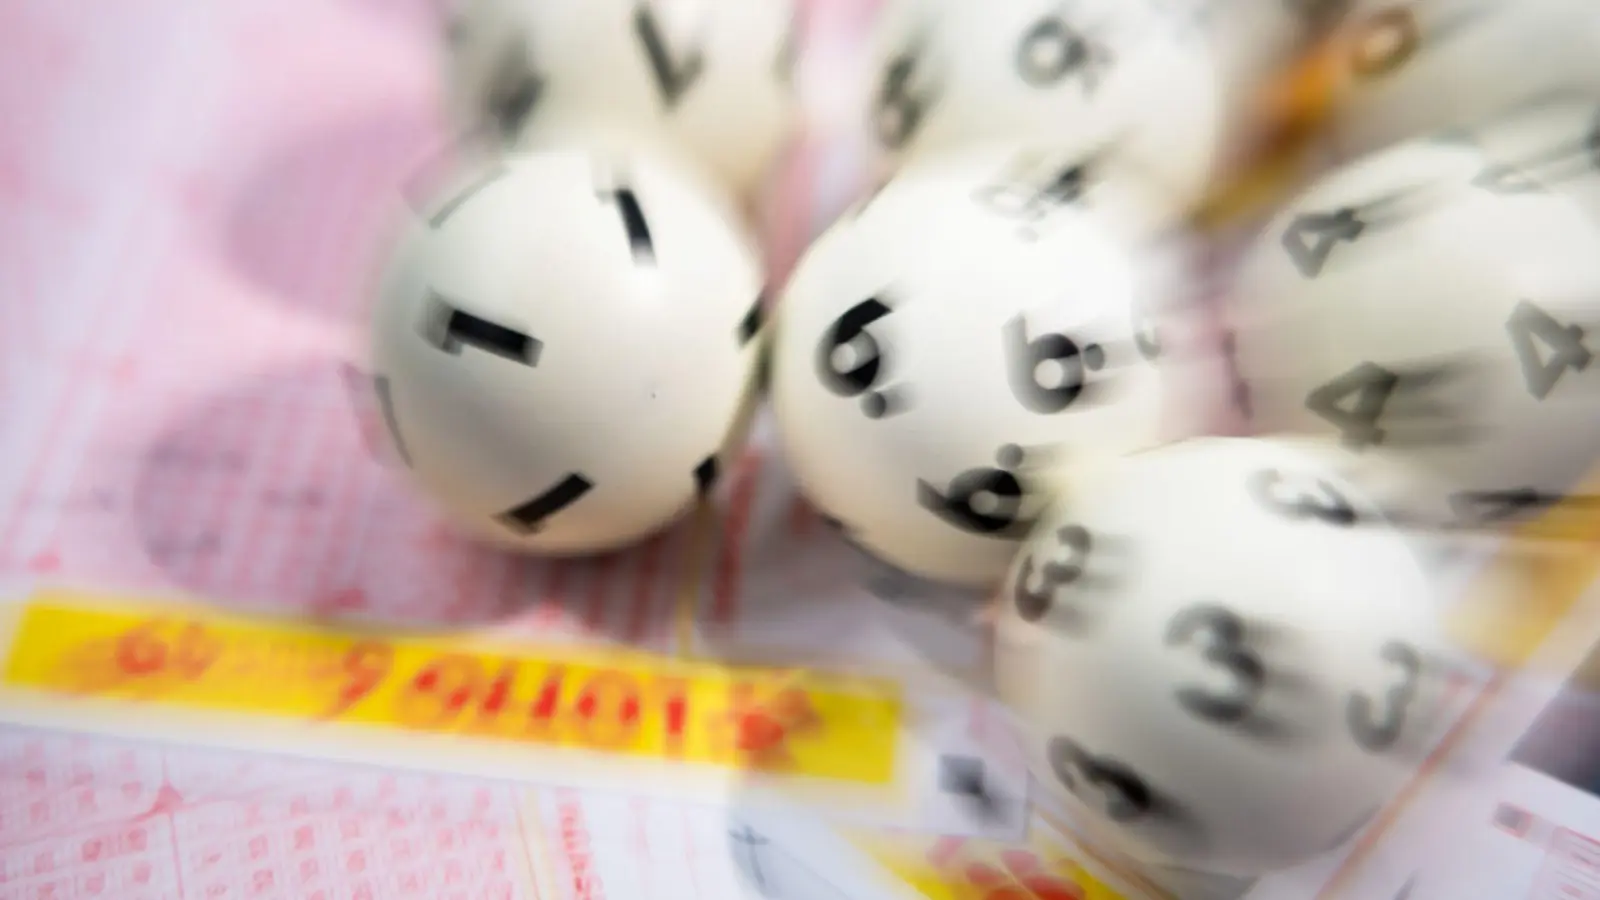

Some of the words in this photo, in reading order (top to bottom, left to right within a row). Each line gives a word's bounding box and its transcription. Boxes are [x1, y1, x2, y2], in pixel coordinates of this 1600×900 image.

[594, 185, 657, 266] 1
[1281, 207, 1366, 280] 4
[415, 288, 543, 367] 1
[1505, 298, 1592, 401] 4
[1304, 360, 1398, 453] 4
[492, 472, 595, 535] 1
[1014, 524, 1091, 622] 3
[398, 648, 690, 760] LOTTO
[1163, 602, 1268, 727] 3
[1346, 641, 1420, 754] 3
